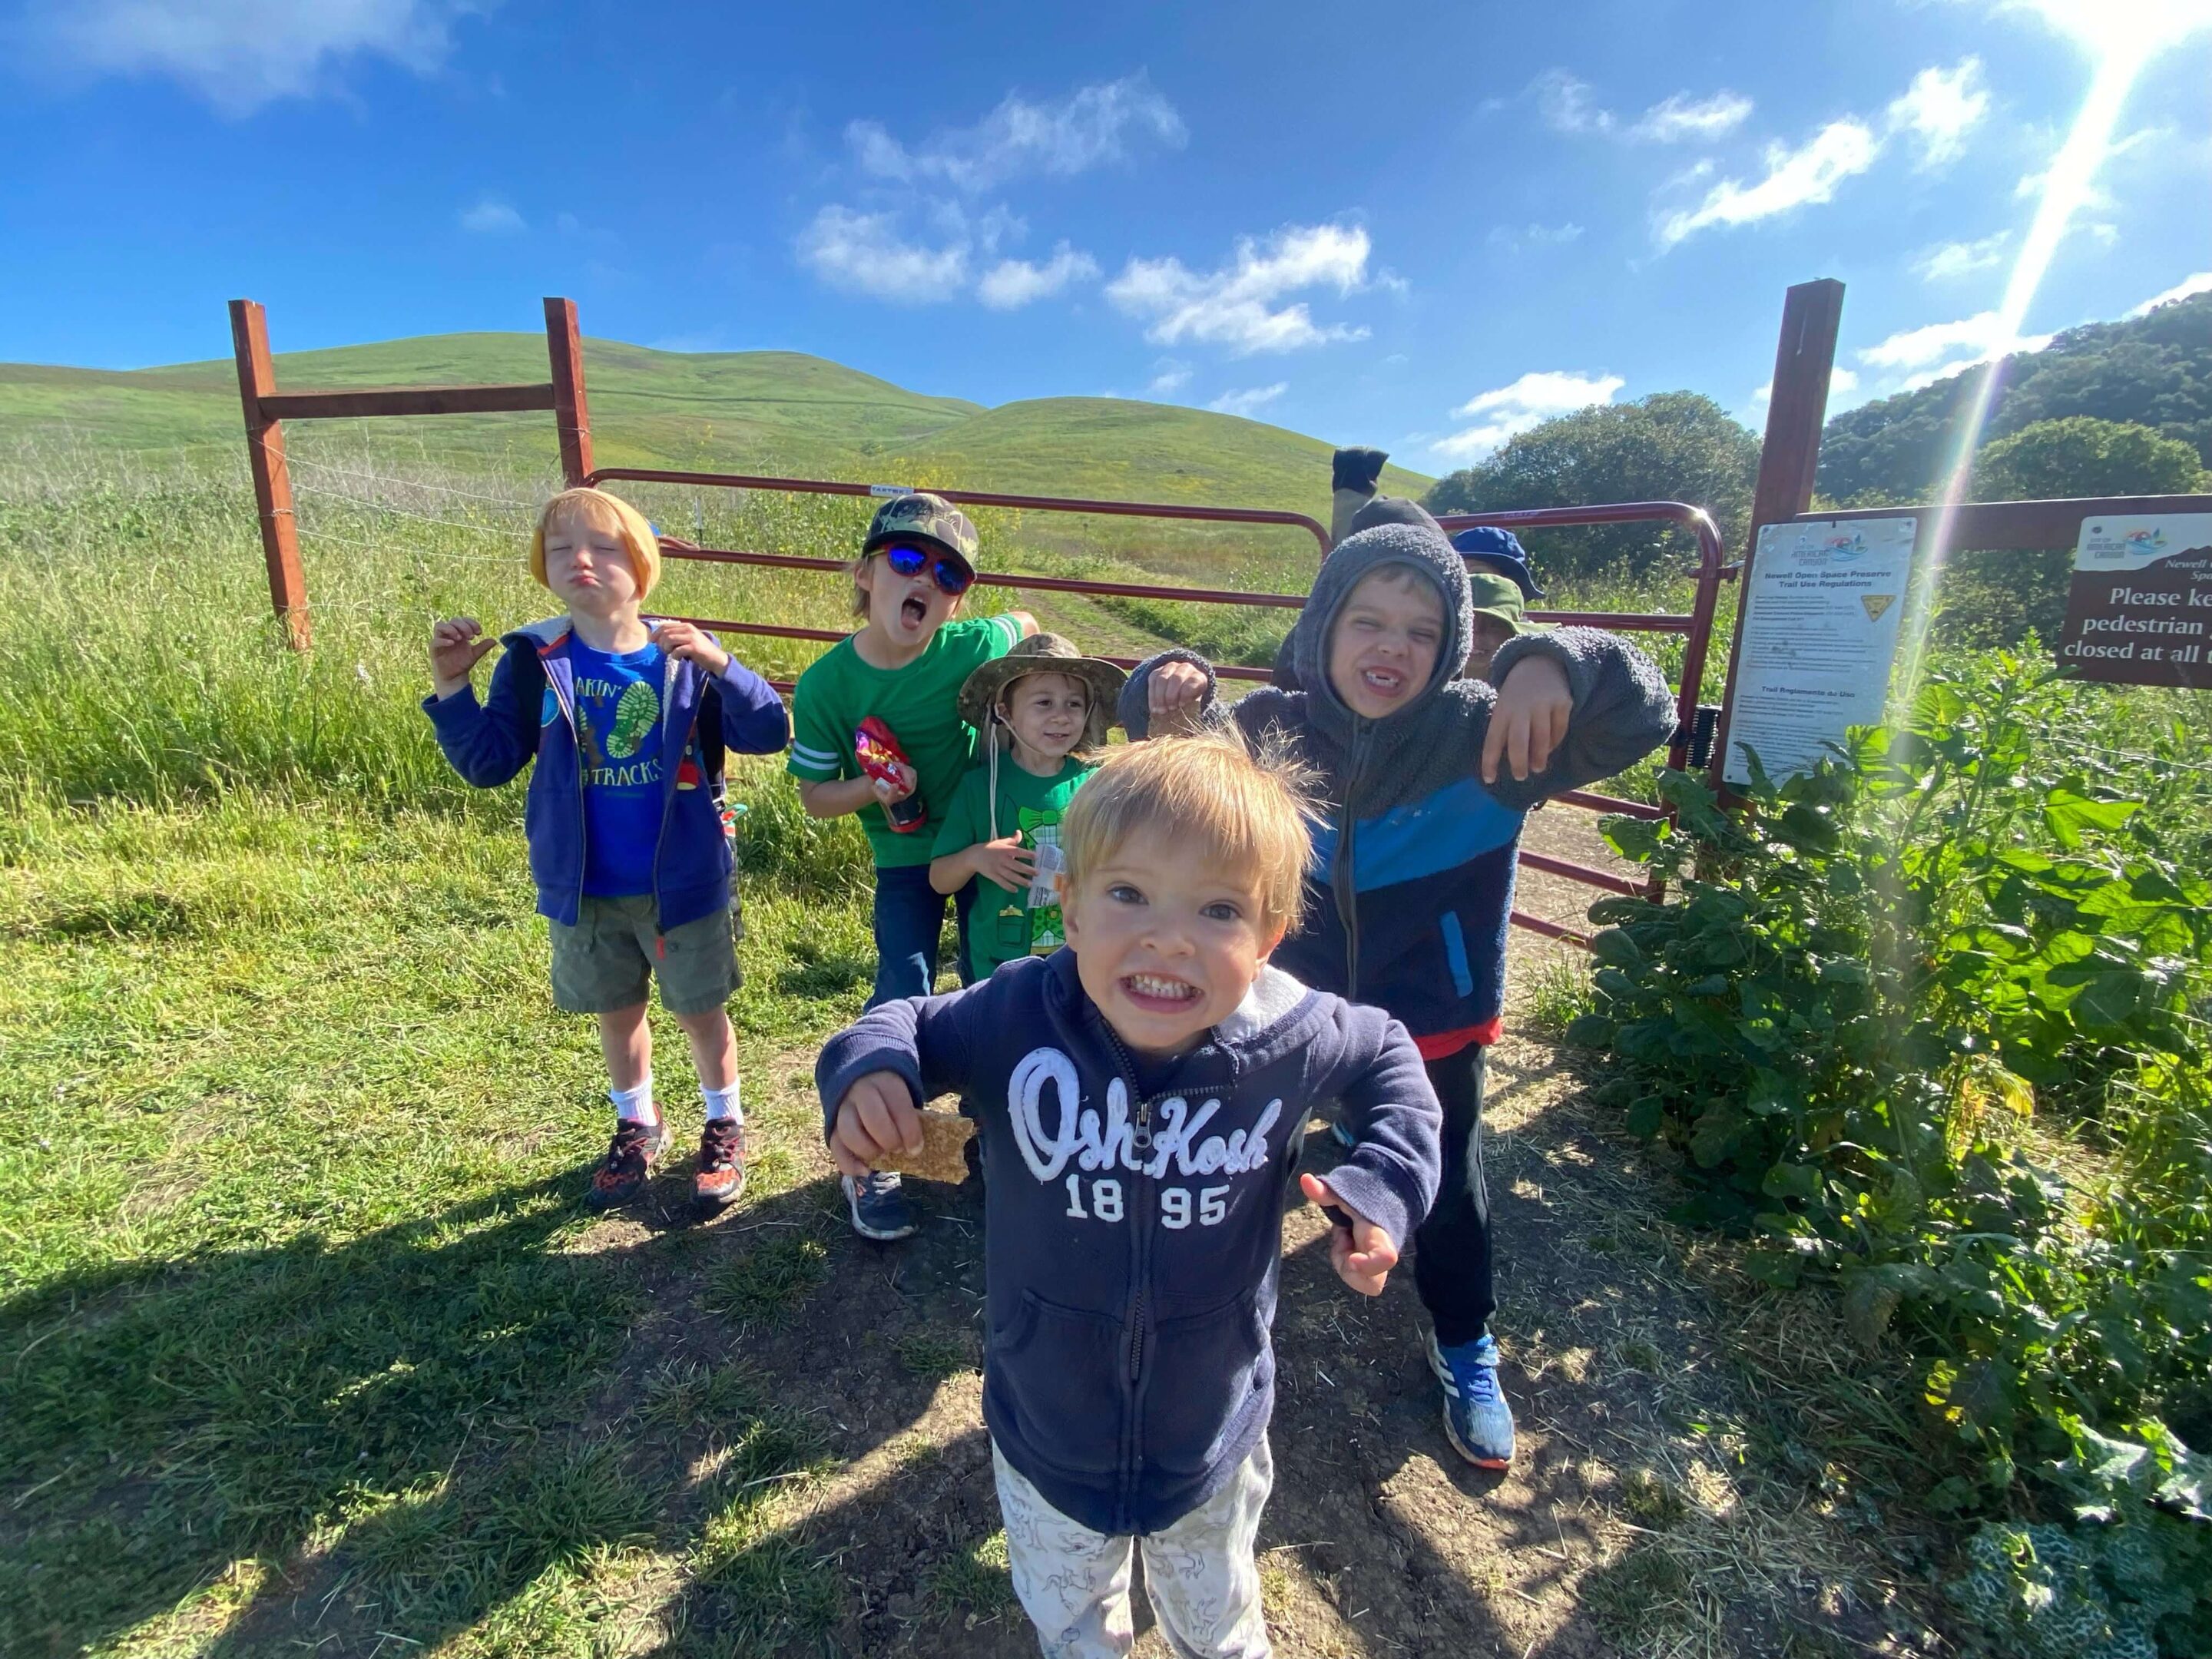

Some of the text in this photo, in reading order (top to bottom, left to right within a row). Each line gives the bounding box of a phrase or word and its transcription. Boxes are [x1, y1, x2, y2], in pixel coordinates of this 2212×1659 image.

[2164, 559, 2207, 568] Newell
[1819, 579, 1873, 589] Regulations
[2109, 587, 2181, 606] Please
[2082, 614, 2203, 635] pedestrian
[2065, 640, 2134, 659] closed
[2140, 646, 2164, 661] at
[2170, 645, 2200, 664] all
[591, 758, 664, 787] TRACKS
